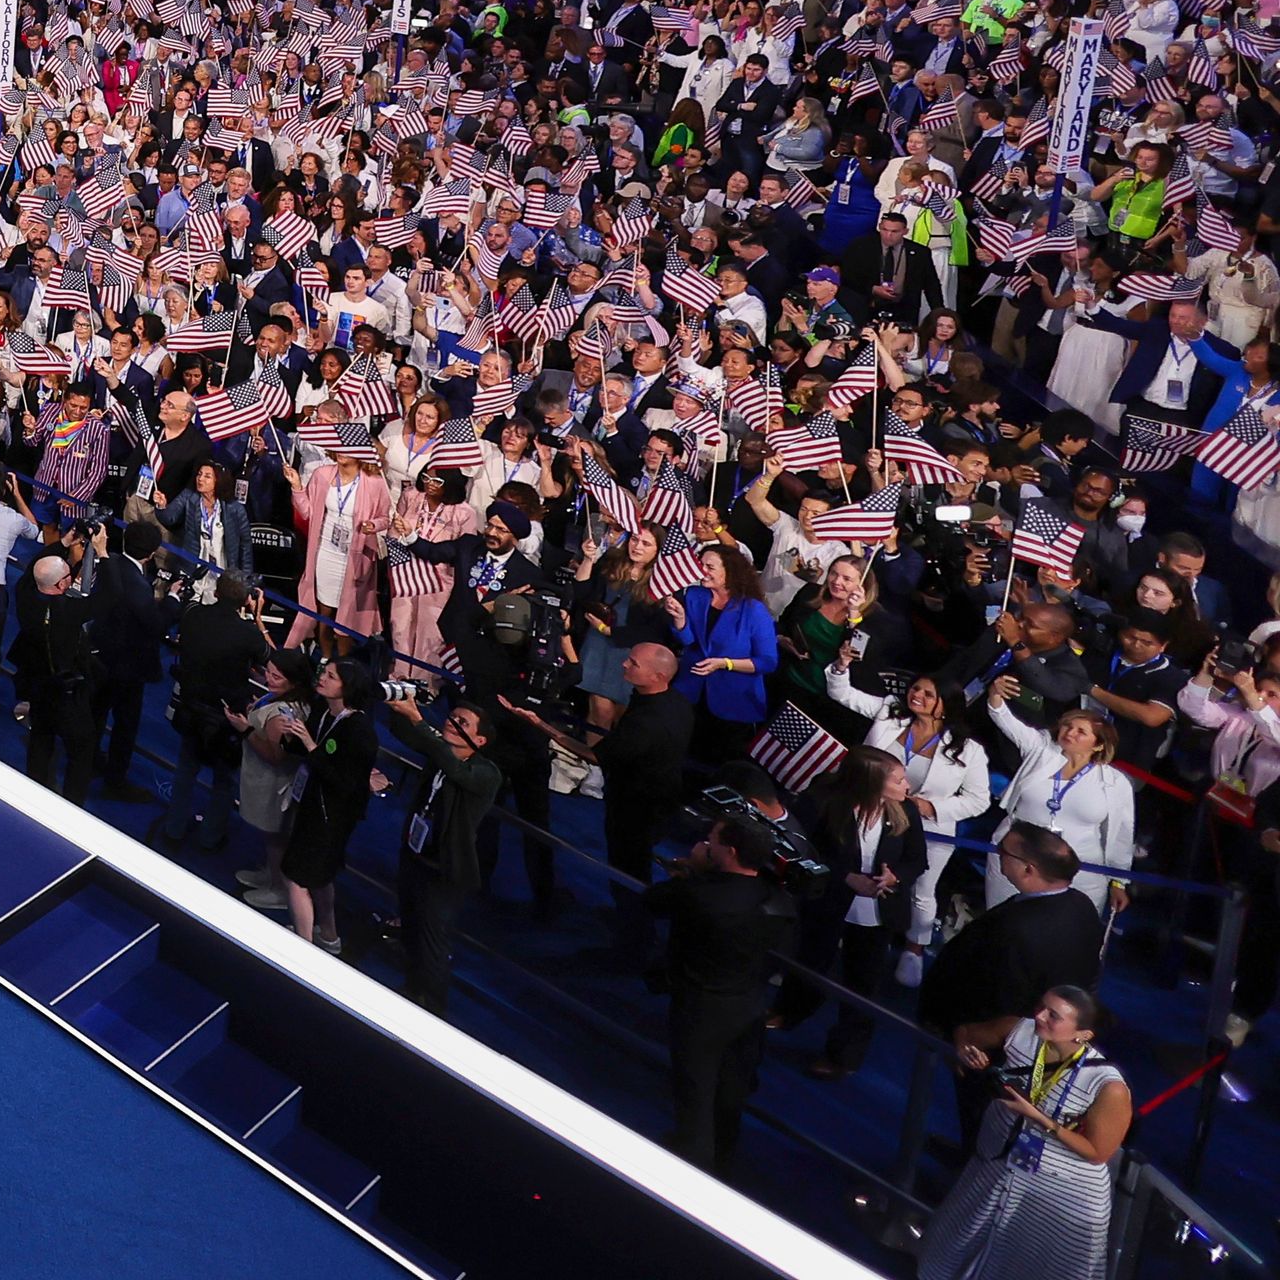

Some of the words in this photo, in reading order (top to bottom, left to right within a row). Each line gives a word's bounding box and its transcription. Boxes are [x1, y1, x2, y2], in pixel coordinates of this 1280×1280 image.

[1052, 36, 1075, 150] MARYLAND
[1067, 39, 1095, 152] MARYLAND
[250, 532, 279, 541] NITED
